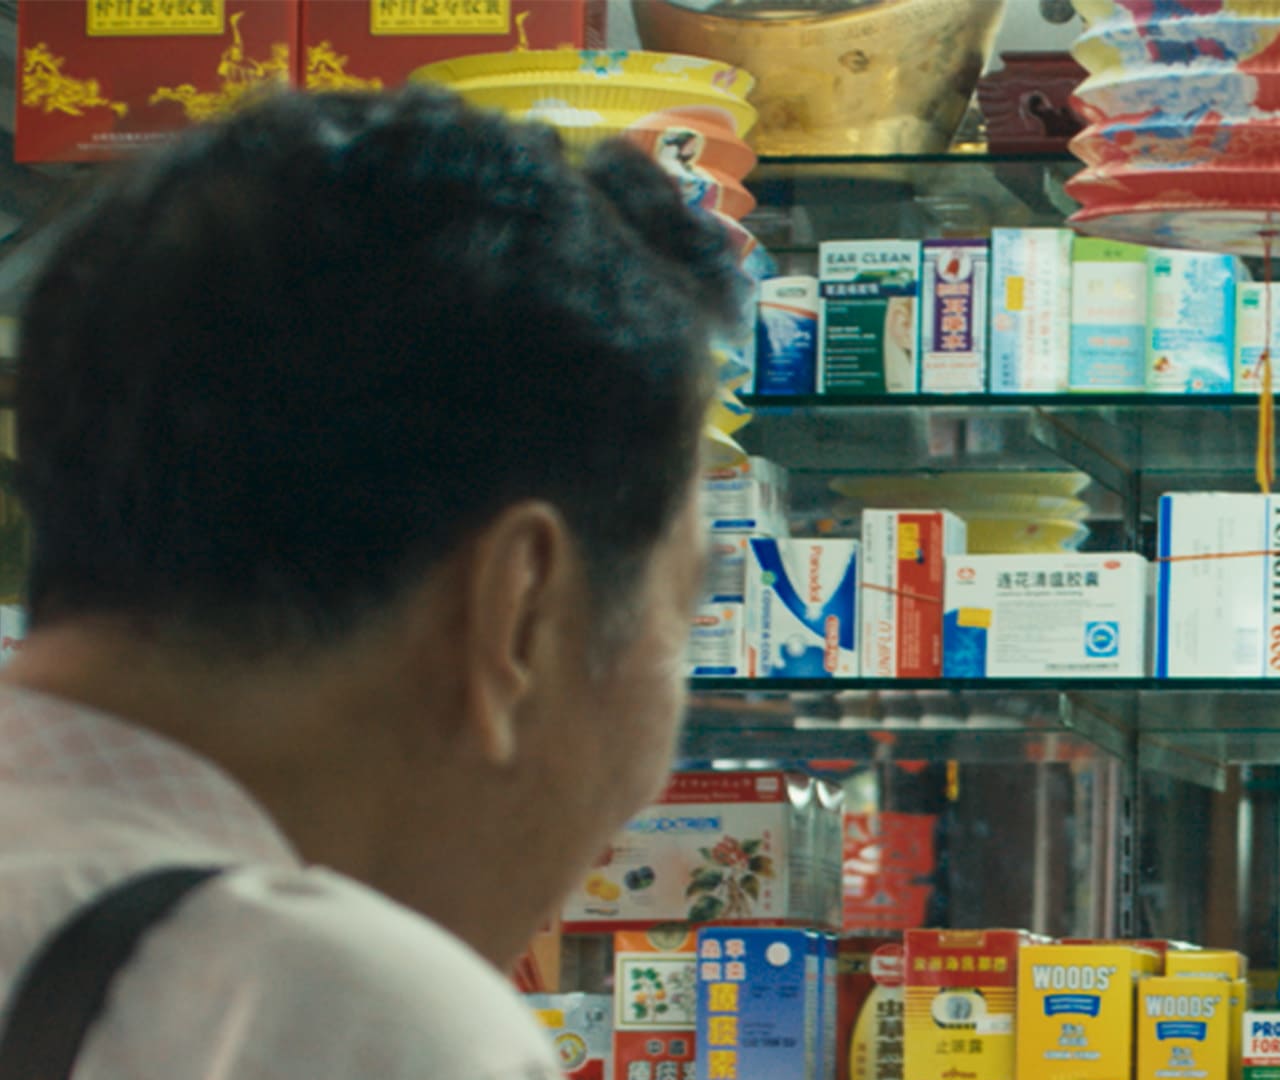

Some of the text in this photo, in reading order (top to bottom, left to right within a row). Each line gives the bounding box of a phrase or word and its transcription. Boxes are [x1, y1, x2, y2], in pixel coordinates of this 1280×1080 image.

[826, 251, 912, 265] EAR CLEAN
[809, 545, 823, 604] Panadol
[761, 588, 772, 630] COUGH
[761, 642, 773, 673] COLD
